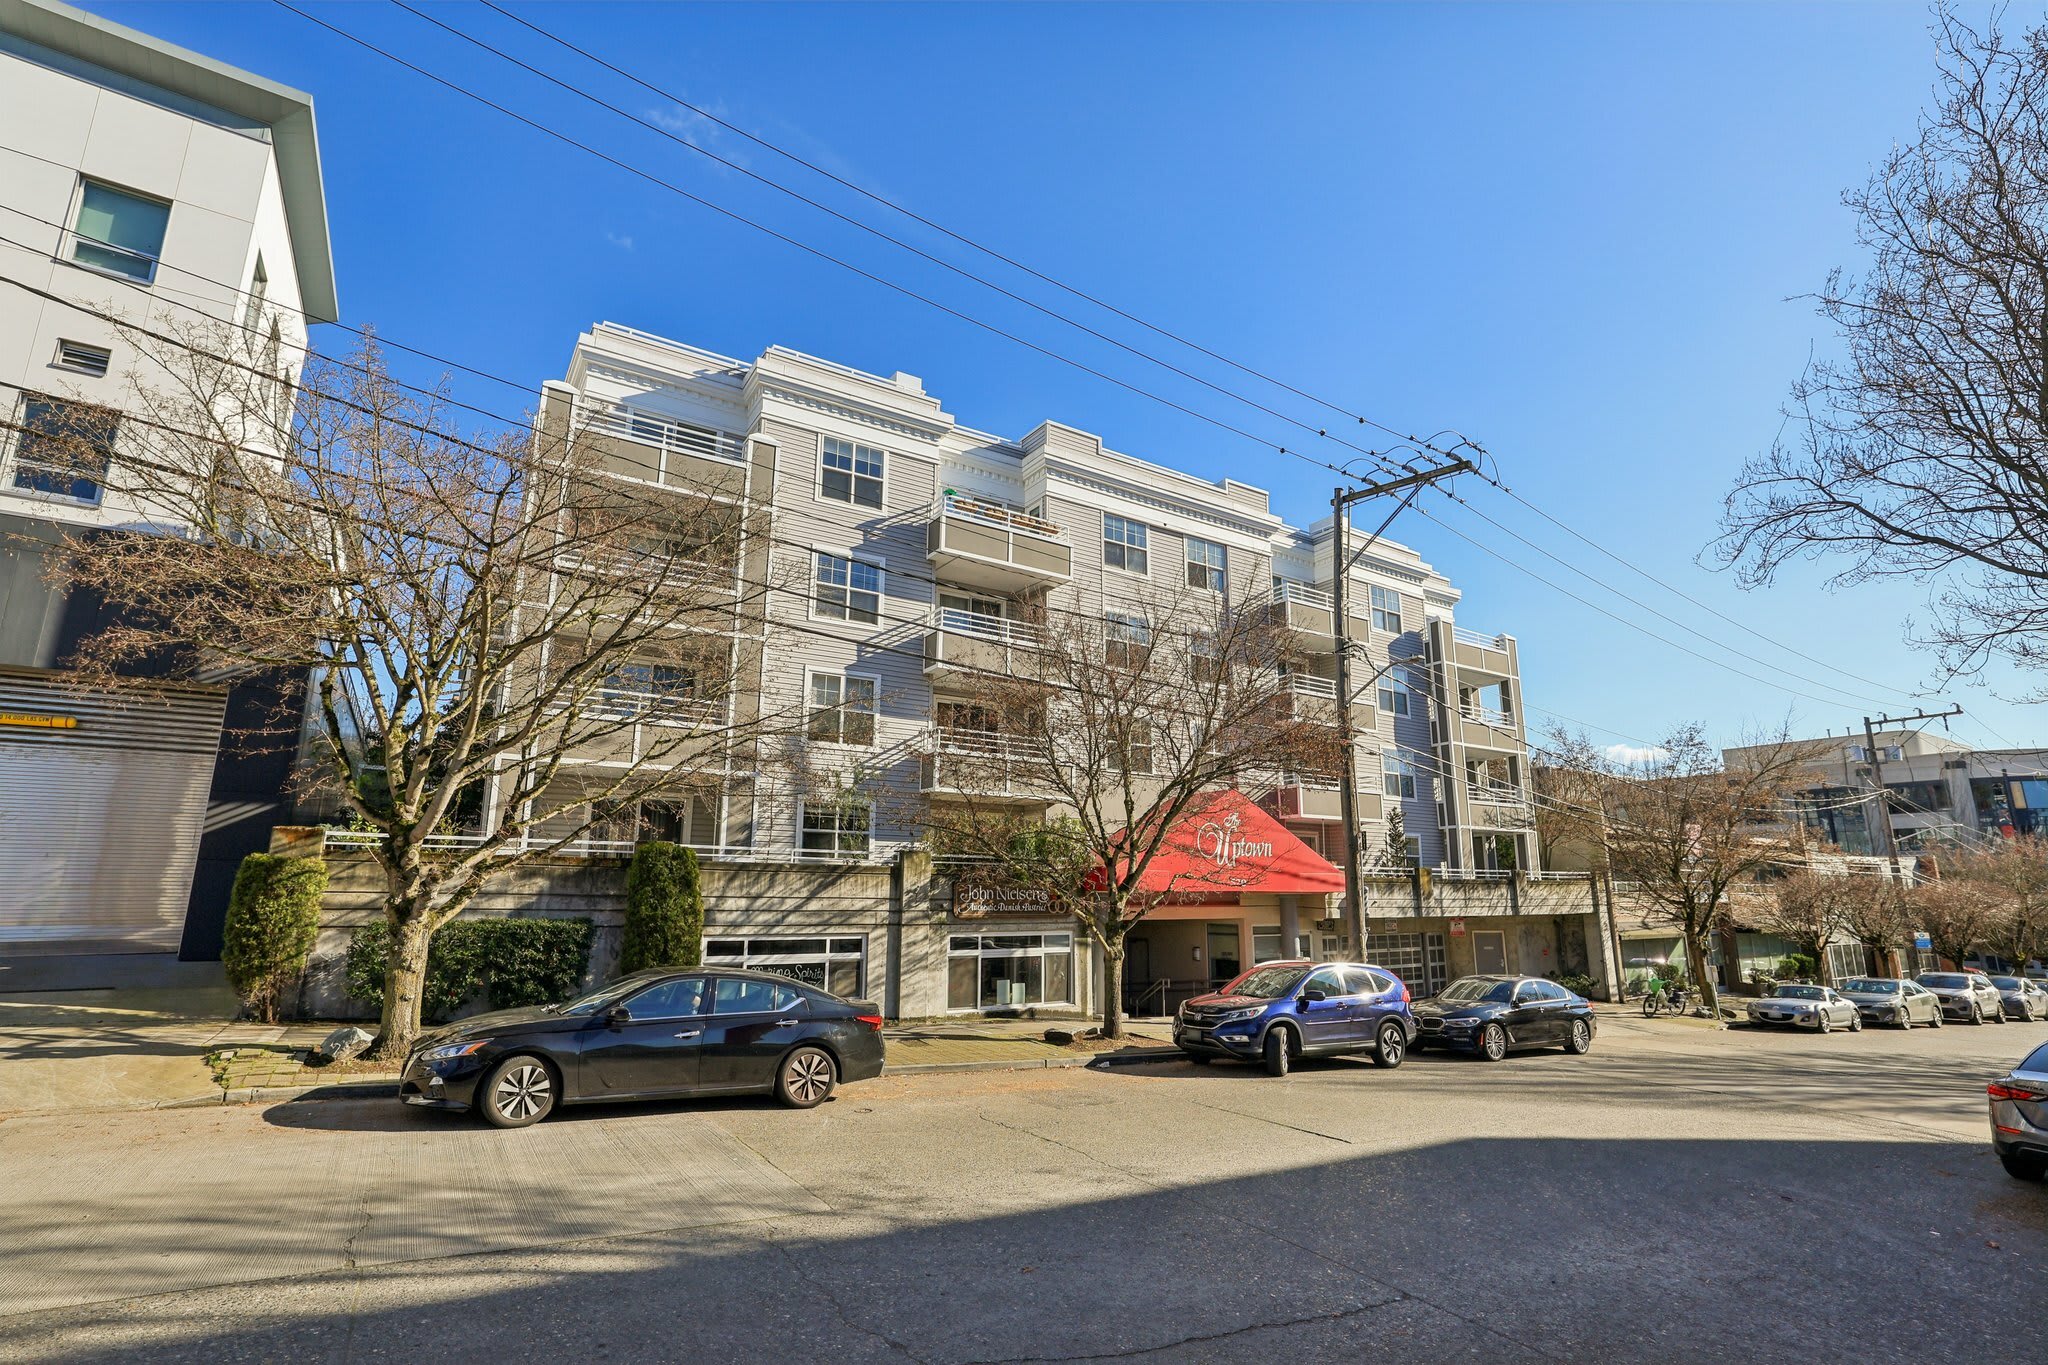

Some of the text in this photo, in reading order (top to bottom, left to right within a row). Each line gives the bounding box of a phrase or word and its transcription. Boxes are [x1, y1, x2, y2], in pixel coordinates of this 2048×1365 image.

[1197, 822, 1273, 868] Uptown
[960, 884, 994, 902] John
[958, 900, 1047, 914] Authentic Danish Pastries
[795, 964, 825, 982] Spirits
